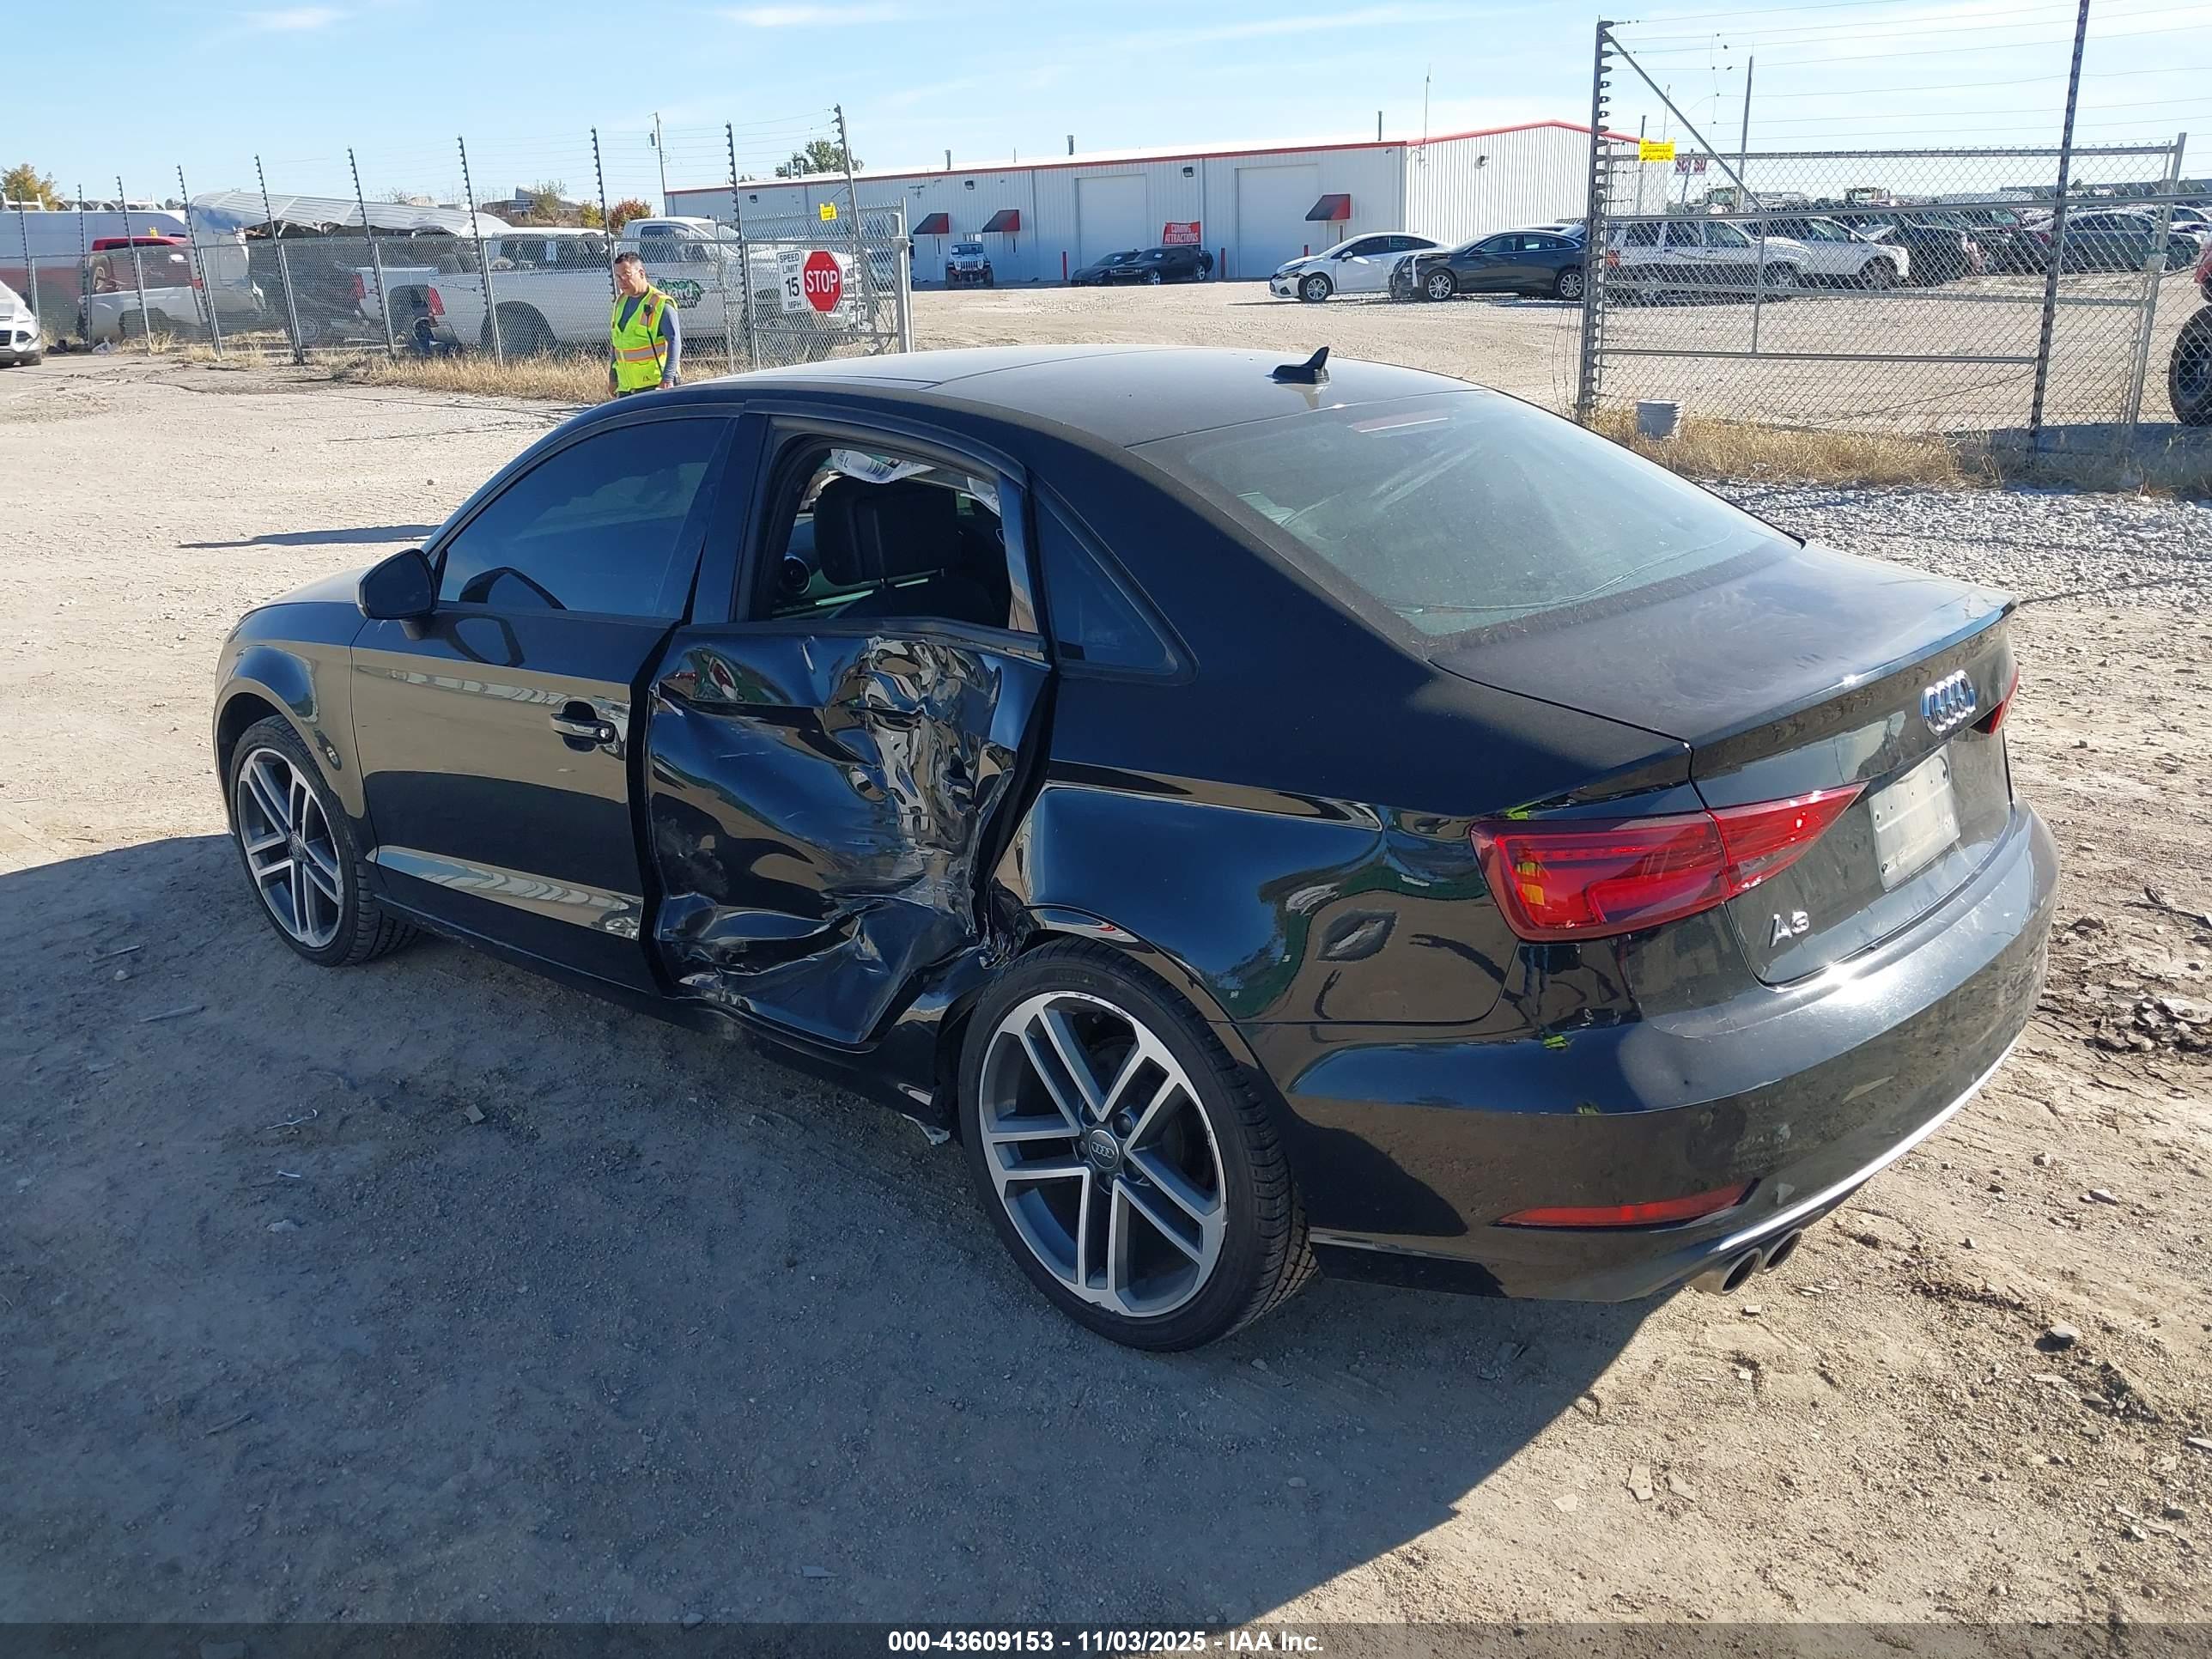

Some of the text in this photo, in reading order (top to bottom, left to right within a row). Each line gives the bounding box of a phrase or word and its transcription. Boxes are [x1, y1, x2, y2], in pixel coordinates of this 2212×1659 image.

[1164, 233, 1199, 243] ATTRACTIONS
[779, 252, 799, 264] SPEED
[781, 264, 799, 274] LIMIT
[785, 276, 800, 297] 15
[805, 269, 838, 293] STOP
[787, 301, 802, 309] MPH
[1769, 911, 1809, 948] A3
